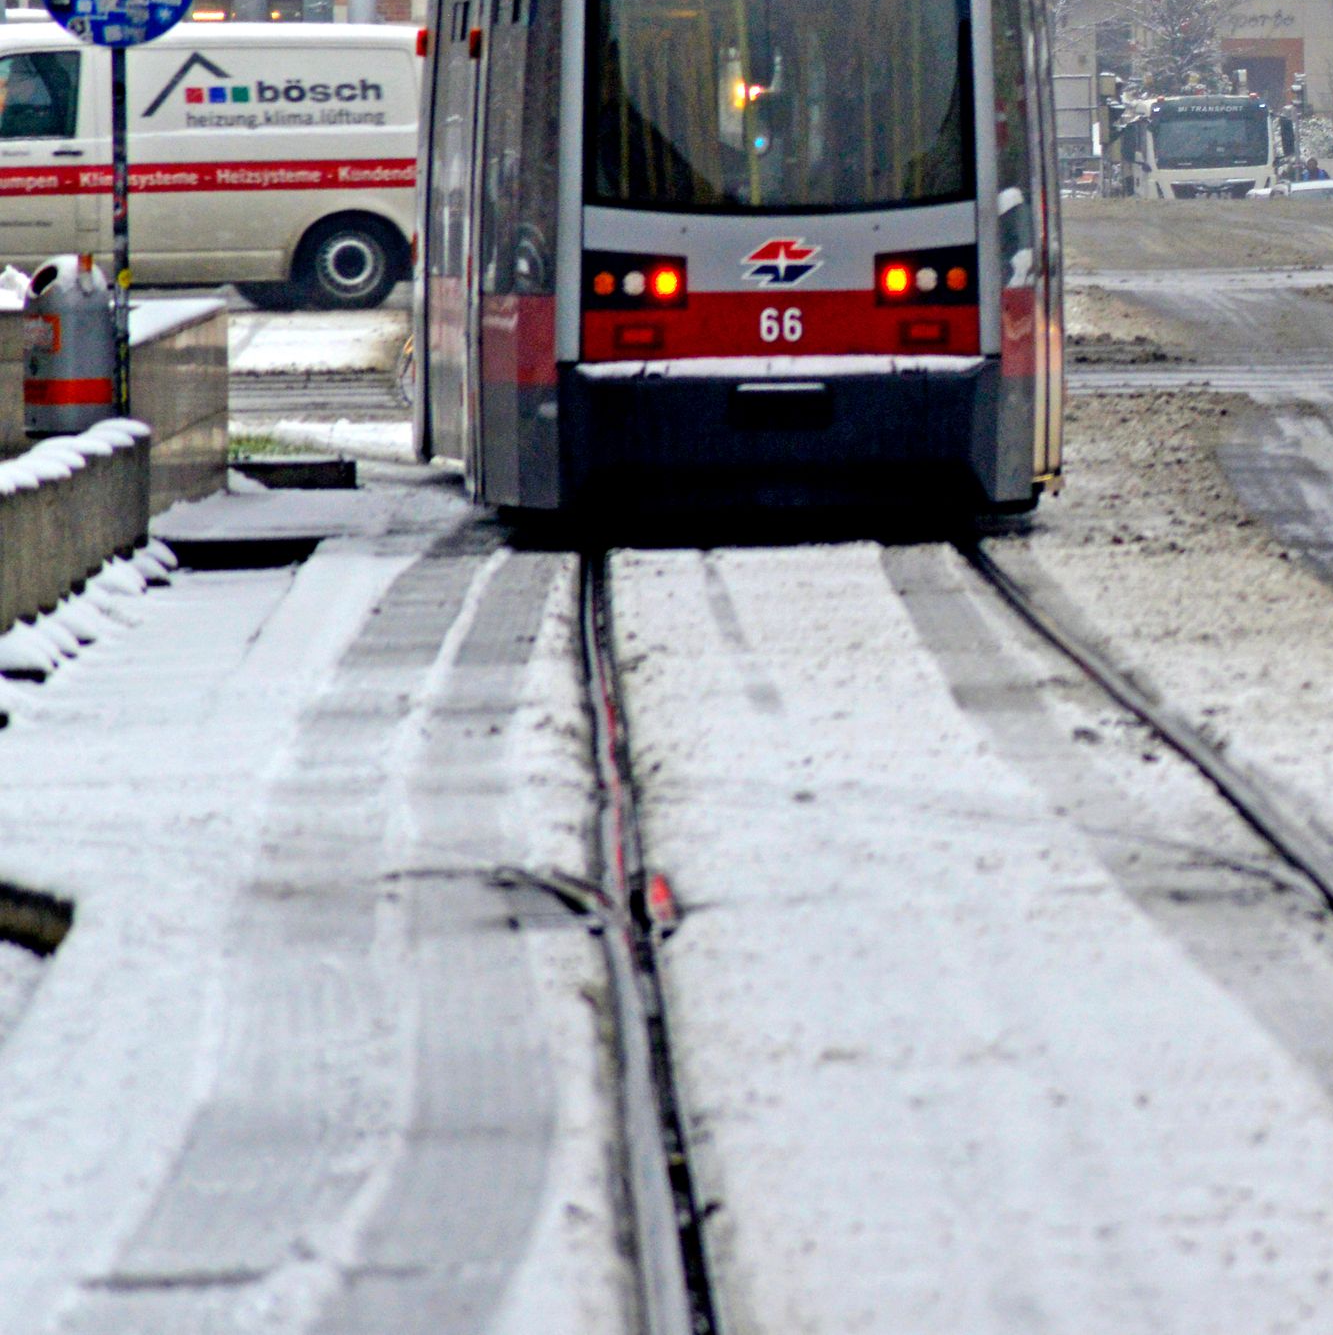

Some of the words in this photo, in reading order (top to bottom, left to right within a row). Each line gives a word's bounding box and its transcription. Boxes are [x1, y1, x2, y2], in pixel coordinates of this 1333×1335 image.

[256, 79, 383, 103] bösch
[186, 109, 386, 128] heizung.klima.lüftung
[79, 171, 198, 189] Klimsysteme
[216, 168, 322, 187] Heizsysteme
[760, 306, 803, 342] 66
